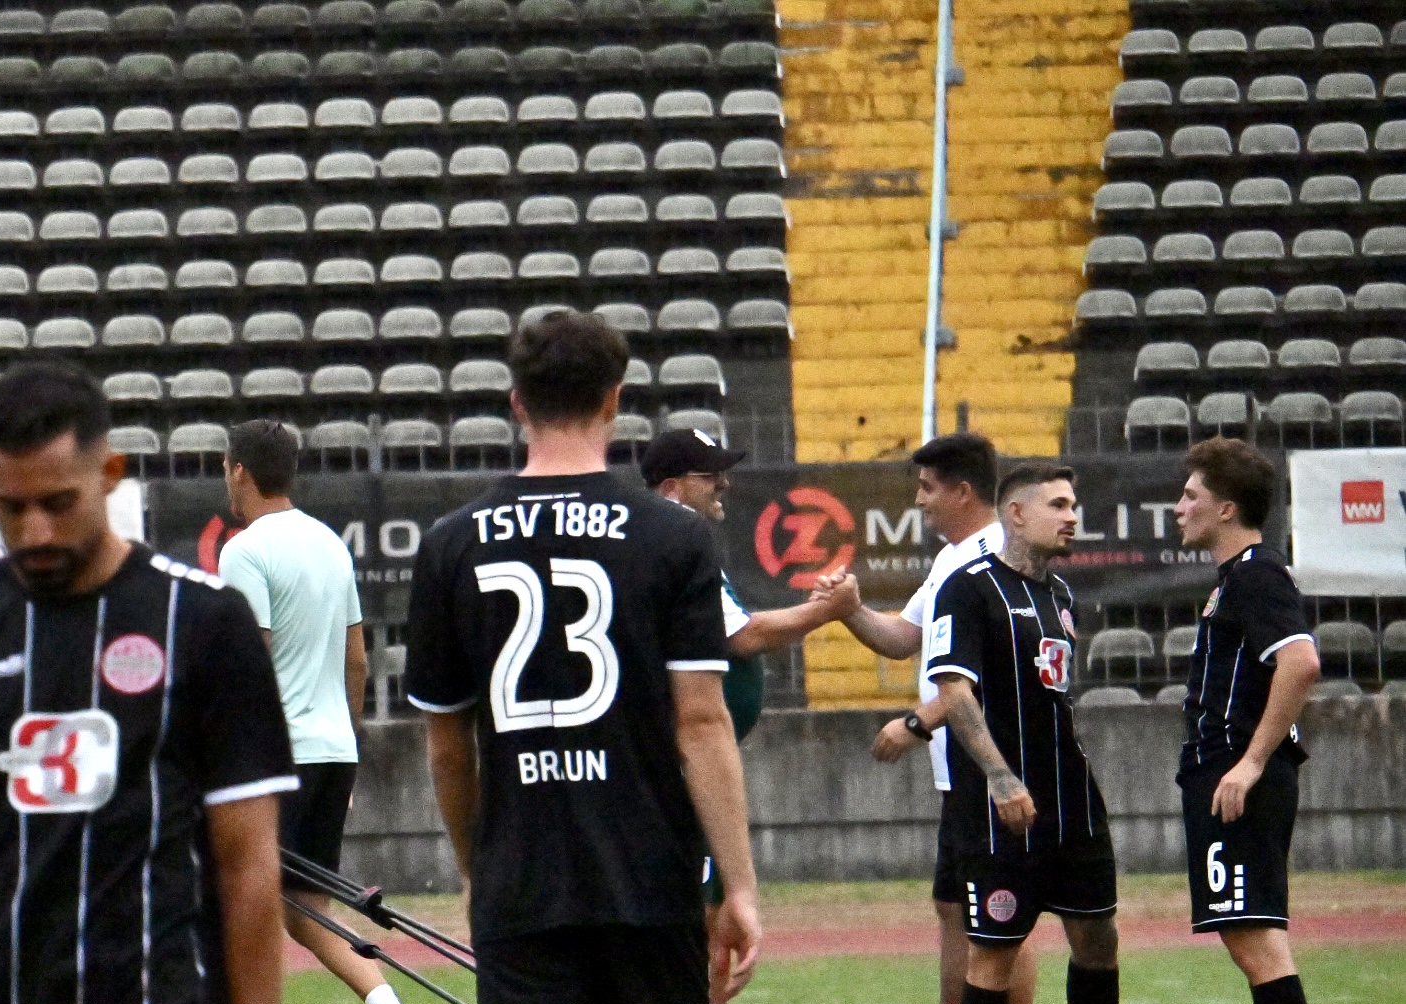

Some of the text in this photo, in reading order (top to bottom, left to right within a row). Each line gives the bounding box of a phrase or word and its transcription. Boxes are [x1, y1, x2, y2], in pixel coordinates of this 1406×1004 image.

[472, 501, 630, 543] TSV 1882
[1073, 502, 1177, 541] LIT
[474, 558, 620, 733] 23
[517, 750, 607, 784] BRUN
[1207, 841, 1227, 893] 6
